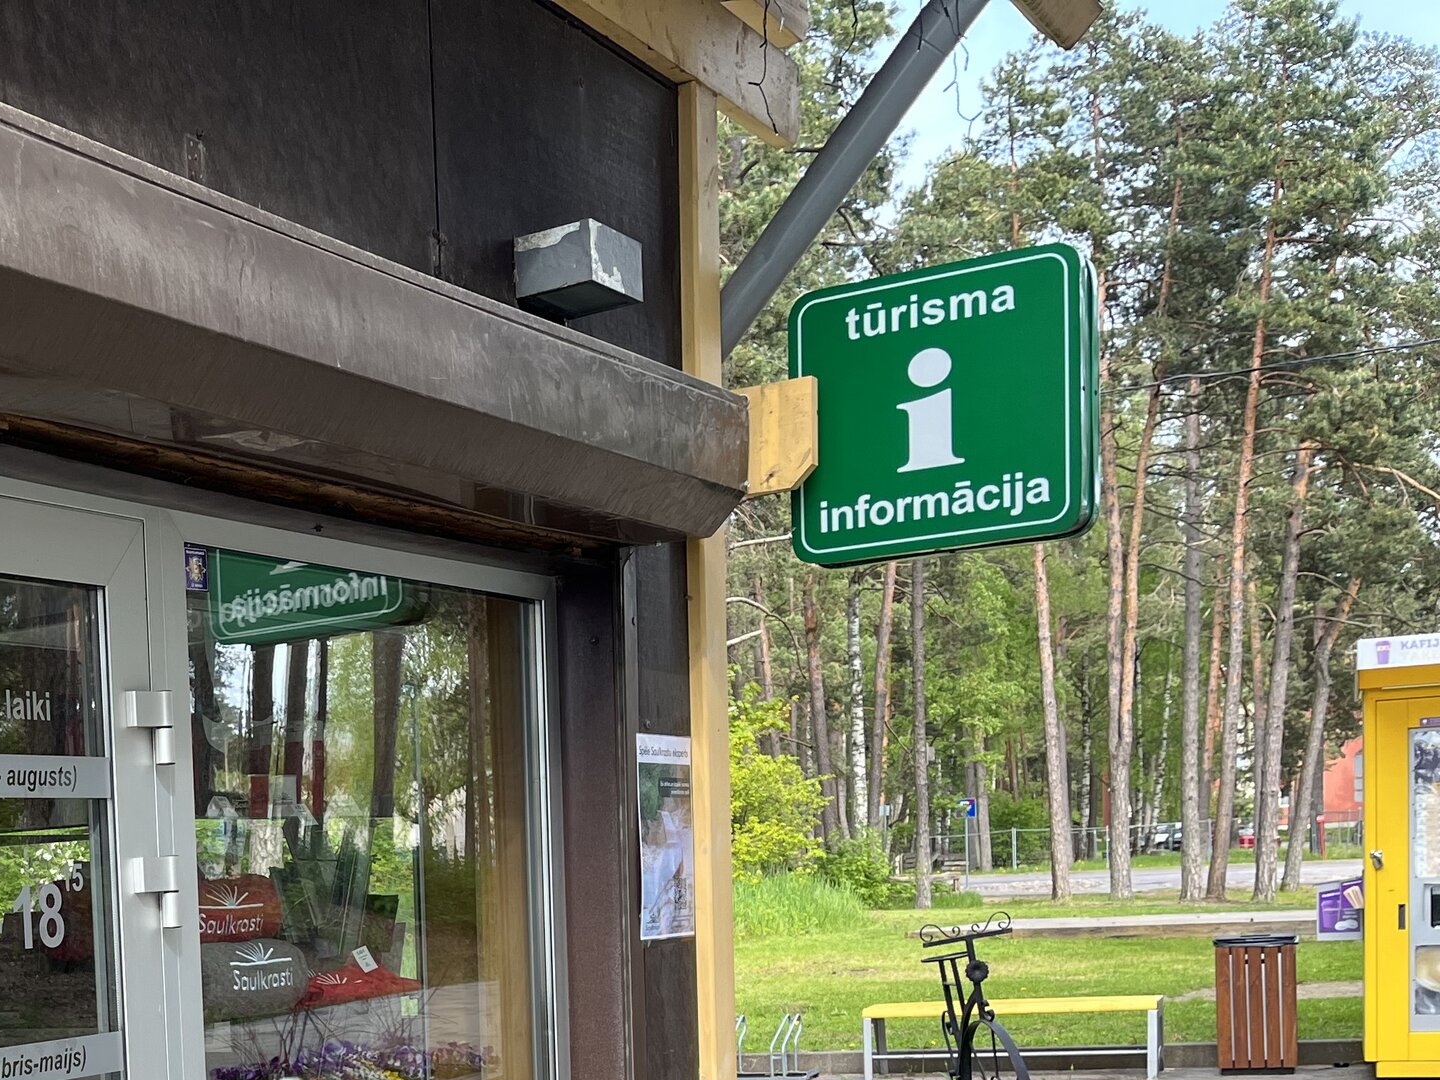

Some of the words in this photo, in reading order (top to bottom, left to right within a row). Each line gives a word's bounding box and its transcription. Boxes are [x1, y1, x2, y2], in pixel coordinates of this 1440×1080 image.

[846, 284, 1016, 340] tūrisma
[820, 472, 1051, 534] informācija
[6, 689, 51, 721] laiki
[7, 764, 77, 792] augusts)
[13, 883, 65, 950] 18
[199, 913, 263, 935] Saulkrasti
[233, 966, 294, 991] Saulkrasti
